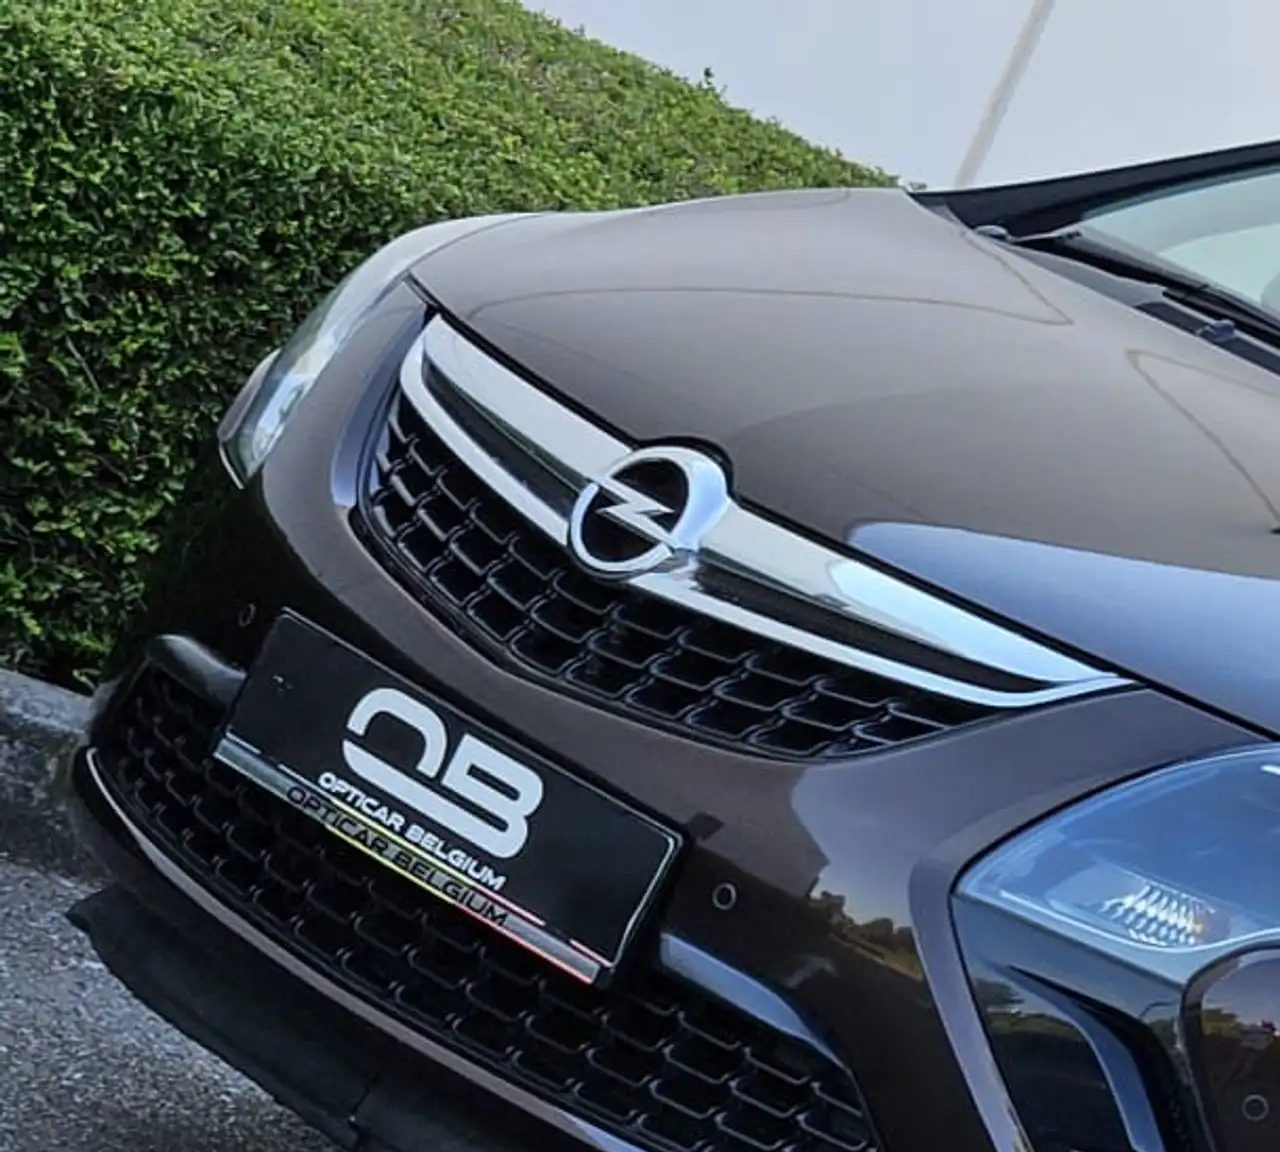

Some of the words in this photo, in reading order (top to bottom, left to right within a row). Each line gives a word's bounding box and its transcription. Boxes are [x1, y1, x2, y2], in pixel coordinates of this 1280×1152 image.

[287, 786, 389, 853] OPTICAR
[393, 850, 508, 927] BELGIUM
[318, 772, 406, 833] OPTICAR
[404, 824, 507, 891] BELGIUM
